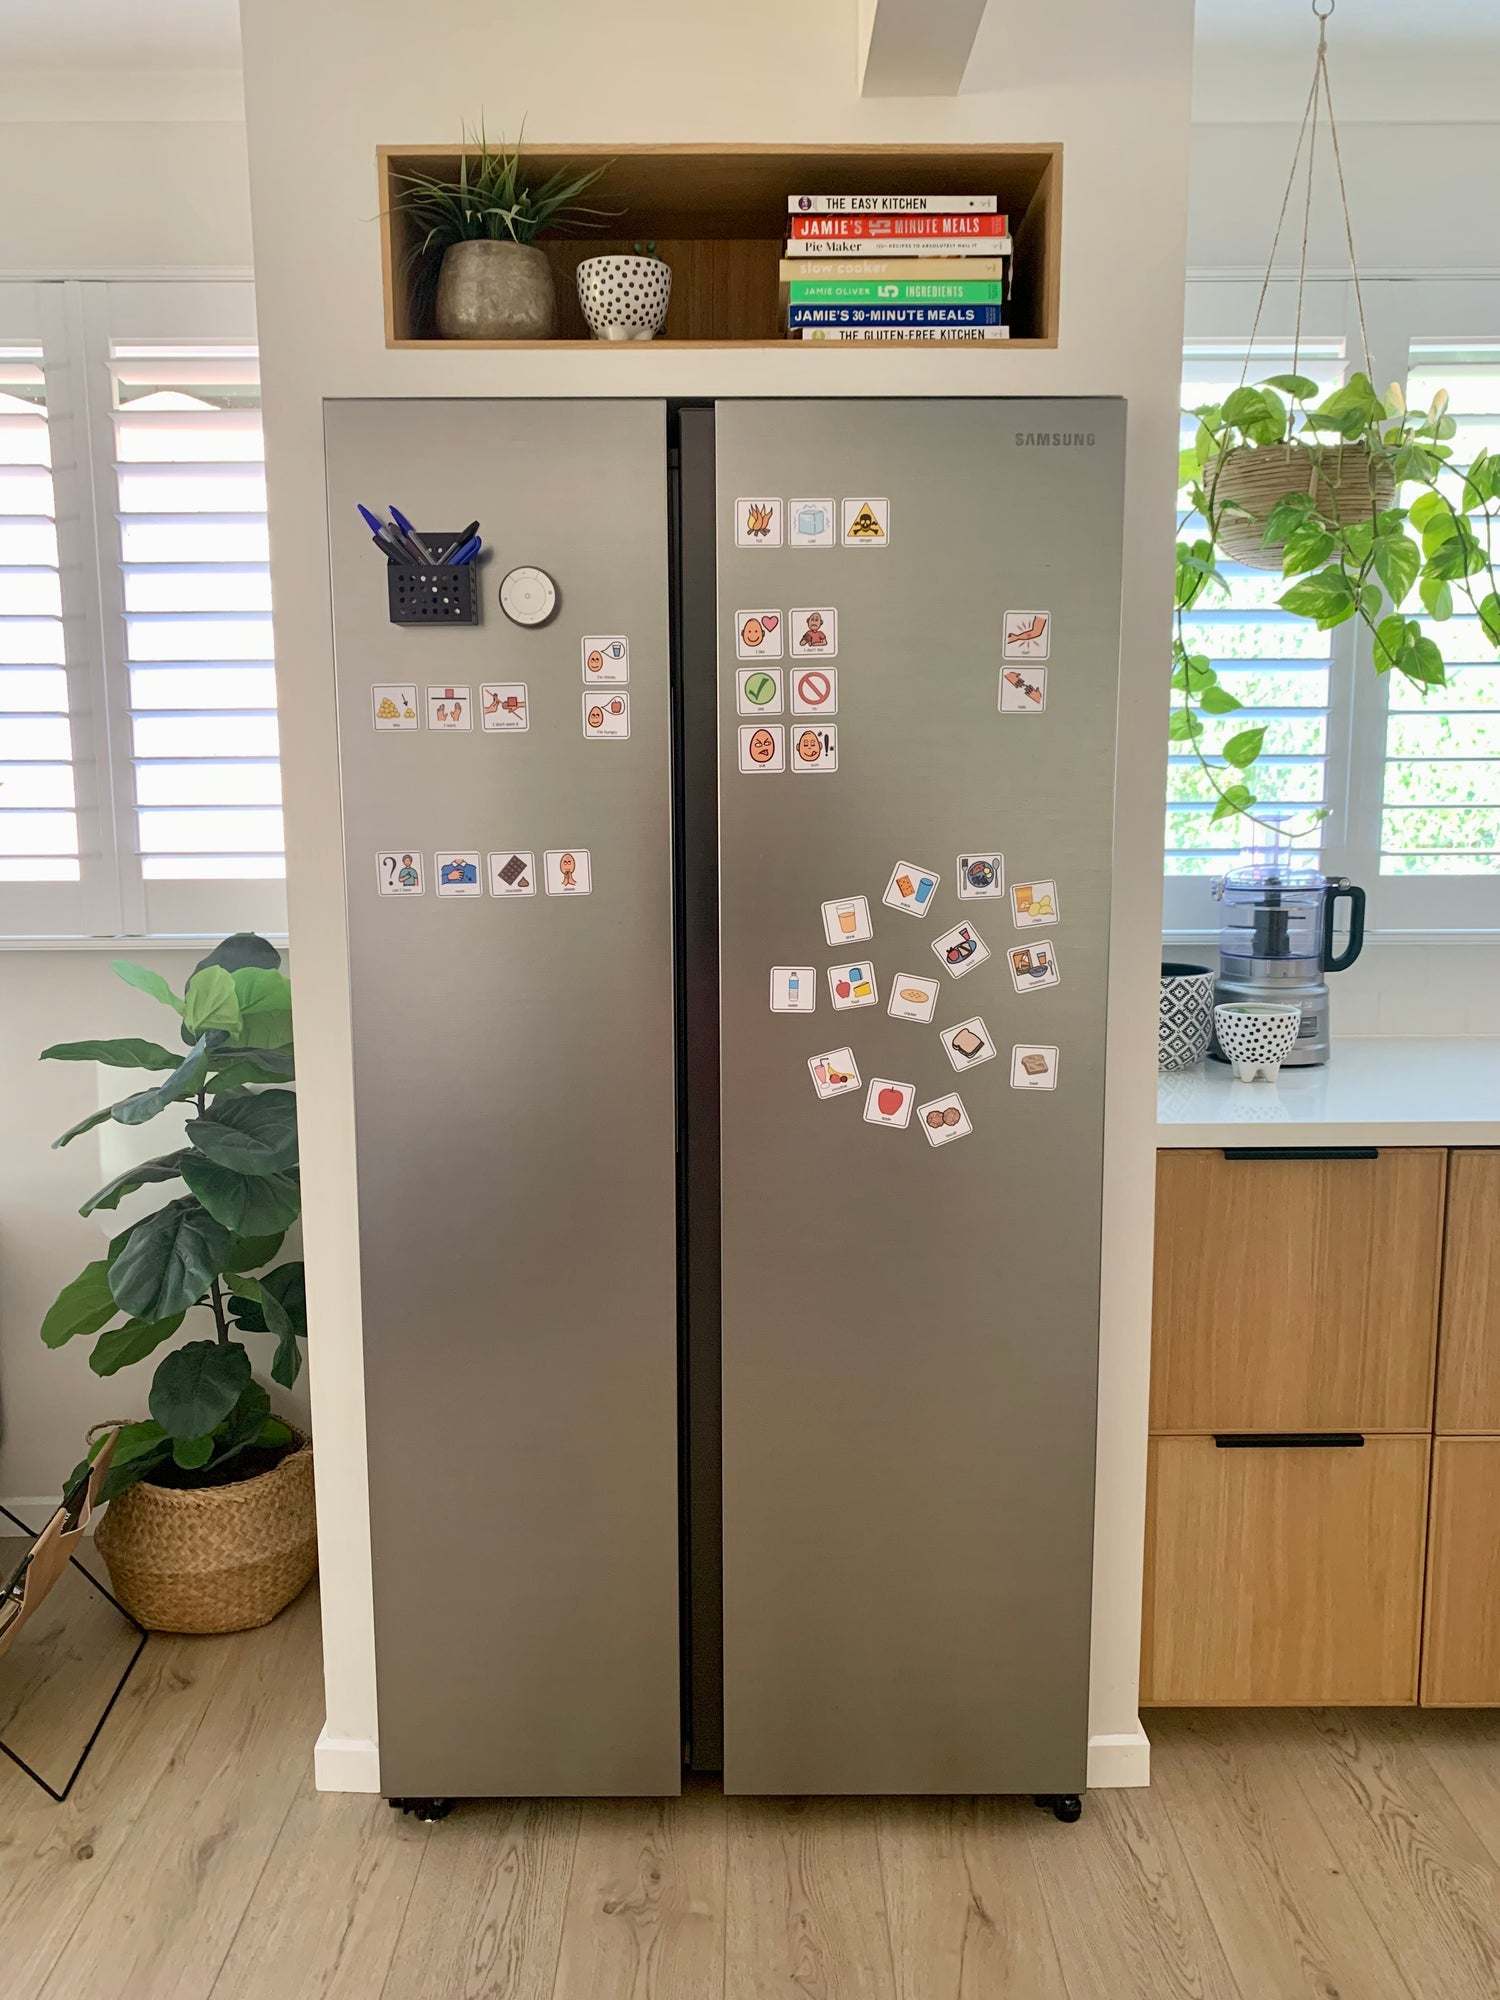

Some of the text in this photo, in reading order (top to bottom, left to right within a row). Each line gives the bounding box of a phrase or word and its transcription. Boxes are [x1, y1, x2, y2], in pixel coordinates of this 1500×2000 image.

[826, 198, 927, 209] THE EASY KITCHEN
[801, 219, 862, 236] JAMIE'S
[895, 218, 937, 234] MINUTE
[943, 217, 979, 233] MEALS
[805, 241, 822, 252] Pie
[826, 241, 862, 252] Maker
[800, 260, 887, 274] slow cooker
[804, 285, 963, 298] JAMIE OLIVER 5 INGREDIENTS
[794, 309, 849, 321] JAMIE'S
[852, 309, 924, 321] 30-MINUTE
[927, 309, 975, 321] MEALS
[940, 329, 985, 340] KITCHEN
[1015, 432, 1096, 447] SAMSUNG
